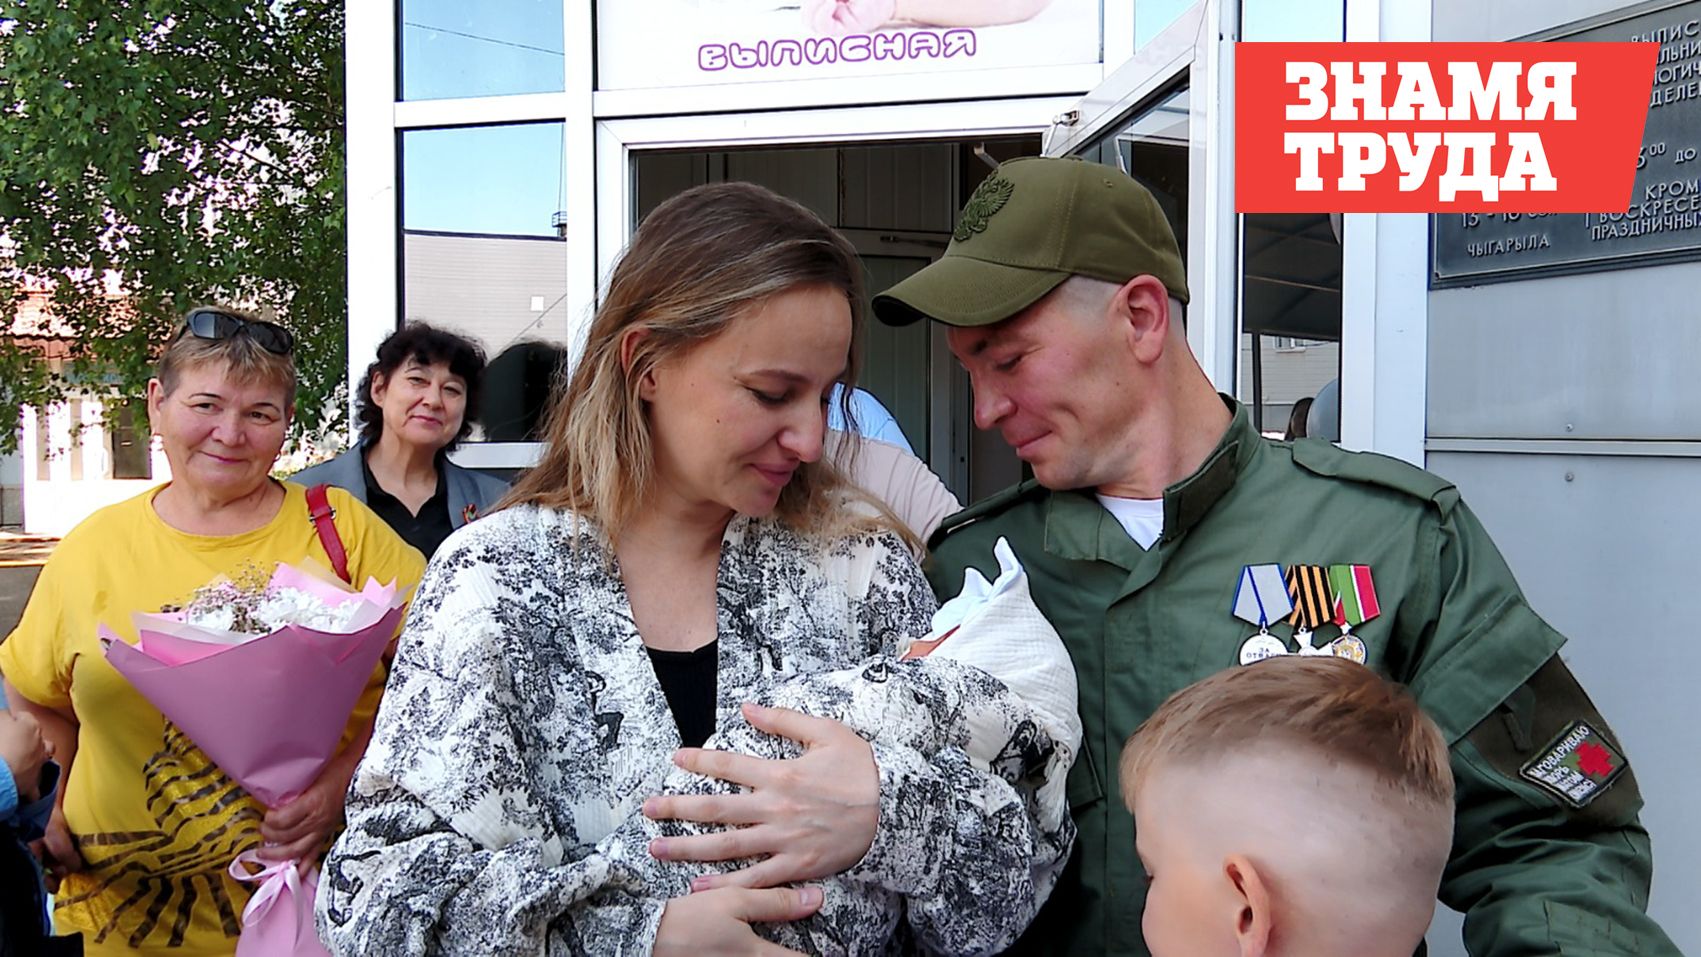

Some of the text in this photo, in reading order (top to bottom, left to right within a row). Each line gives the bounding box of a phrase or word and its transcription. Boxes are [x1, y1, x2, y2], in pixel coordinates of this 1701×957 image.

[698, 29, 977, 71] ВЫПИСНАЯ
[1656, 39, 1701, 65] ЛЬНИ
[1649, 80, 1701, 109] ДЕЛЕ
[1592, 211, 1701, 241] ПРАЗДНИЧНЫ
[1467, 234, 1550, 257] ЧЫГАРЫЛА
